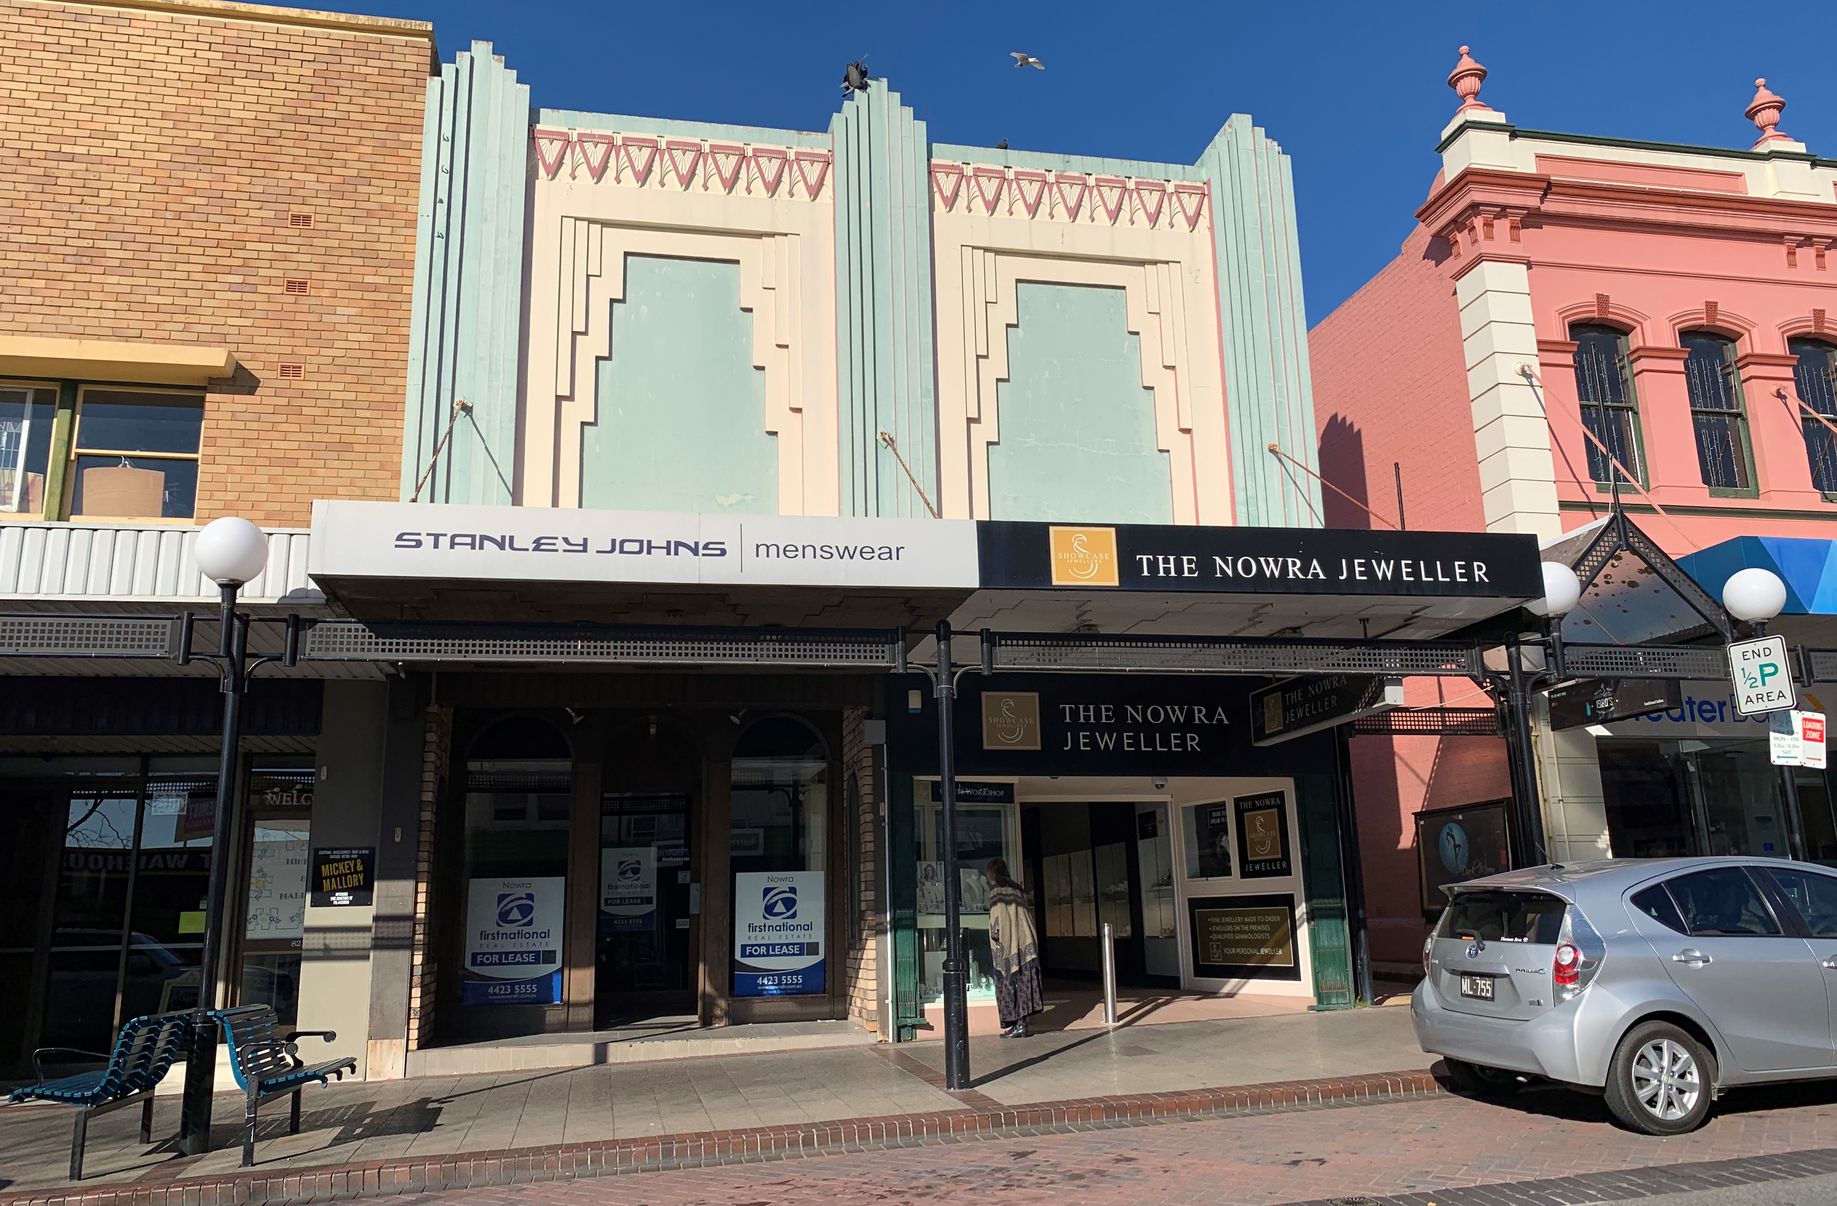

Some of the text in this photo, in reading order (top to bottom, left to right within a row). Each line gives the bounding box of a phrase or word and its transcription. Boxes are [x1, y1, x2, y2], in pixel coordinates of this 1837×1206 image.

[394, 531, 727, 557] STANLEY JOHNS
[755, 541, 905, 561] menswear
[1056, 552, 1111, 560] SHOWCASE
[1136, 554, 1490, 583] THE NOWRA JEWELLER
[1742, 647, 1772, 661] END
[1284, 674, 1348, 706] THE NOWRA
[1745, 690, 1787, 706] AREA
[1059, 704, 1230, 725] THE NOWRA
[1285, 695, 1337, 724] JEWELLER
[1063, 731, 1201, 751] JEWELLER
[1240, 797, 1281, 810] THE NOWRA
[321, 858, 364, 877] MICKEY &
[1245, 860, 1287, 872] JEWELLER
[322, 873, 364, 892] MALLORY
[502, 881, 532, 889] Nowra
[746, 945, 800, 955] FOR LEASE
[477, 953, 536, 964] FOR LEASE
[757, 975, 803, 985] 4423 5555
[488, 984, 538, 994] 4423 5555
